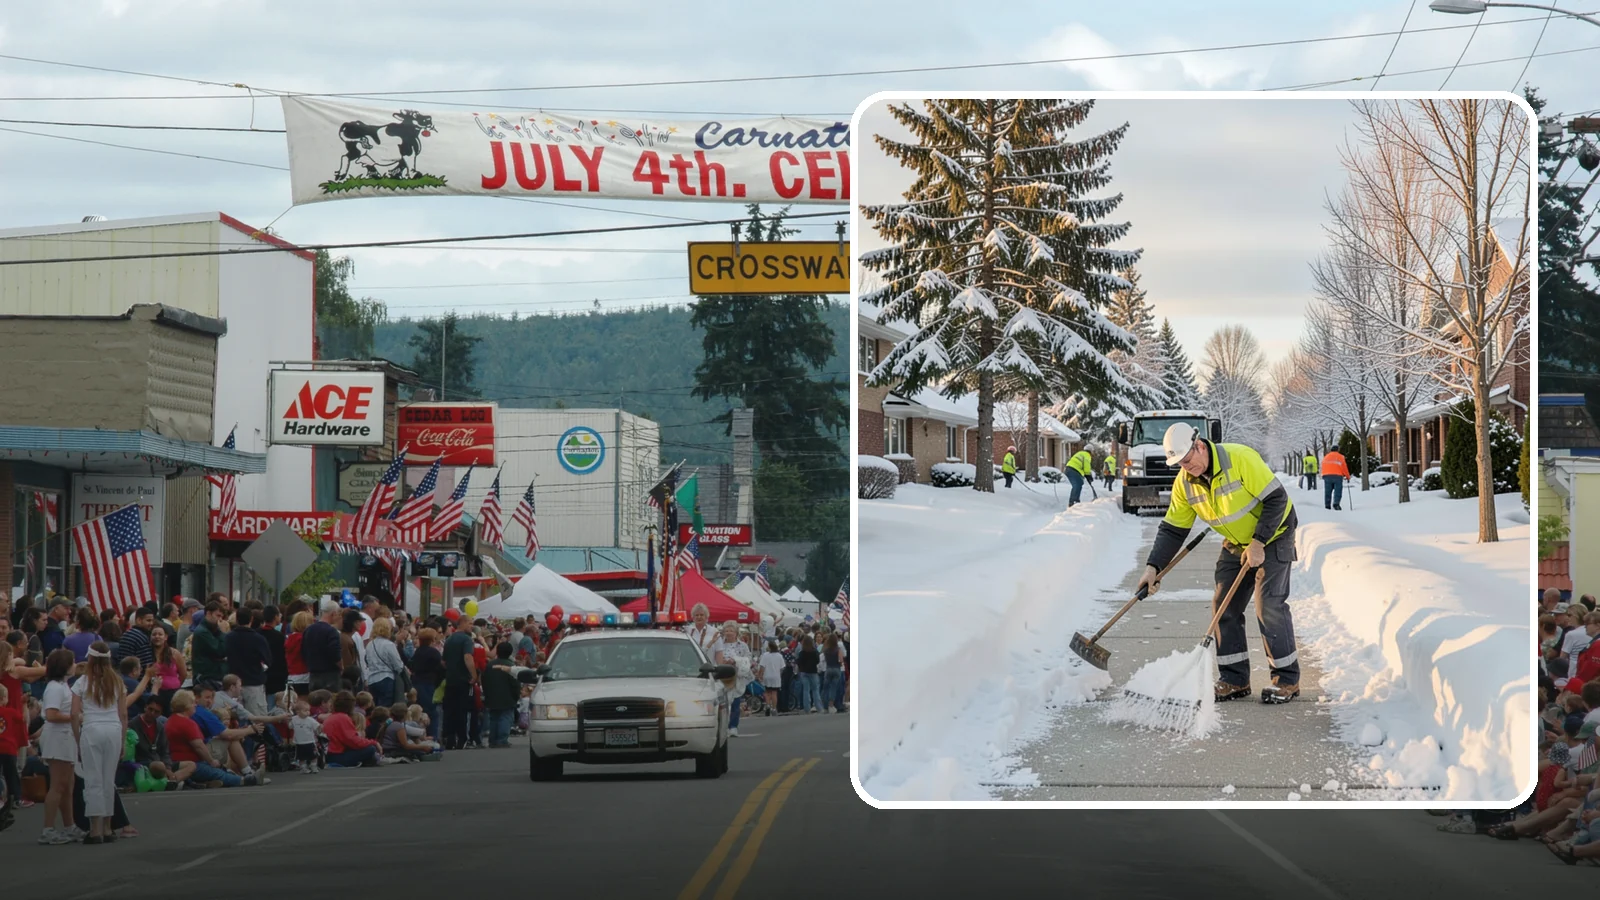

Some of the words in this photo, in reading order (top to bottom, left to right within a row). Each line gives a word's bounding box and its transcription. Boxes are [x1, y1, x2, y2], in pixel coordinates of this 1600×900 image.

[695, 121, 850, 149] Carnat
[481, 141, 604, 192] JULY
[632, 150, 746, 197] 4th.
[697, 254, 850, 279] CROSSWA
[283, 380, 373, 420] ACE
[405, 409, 452, 421] CEDAR
[283, 421, 371, 436] Hardware
[416, 428, 477, 447] Coca-Cola
[353, 466, 385, 480] Simpl
[96, 484, 124, 494] Vincent
[126, 486, 135, 494] de
[138, 486, 155, 495] Paul
[688, 526, 741, 535] CRNATION
[699, 535, 730, 543] GLASS
